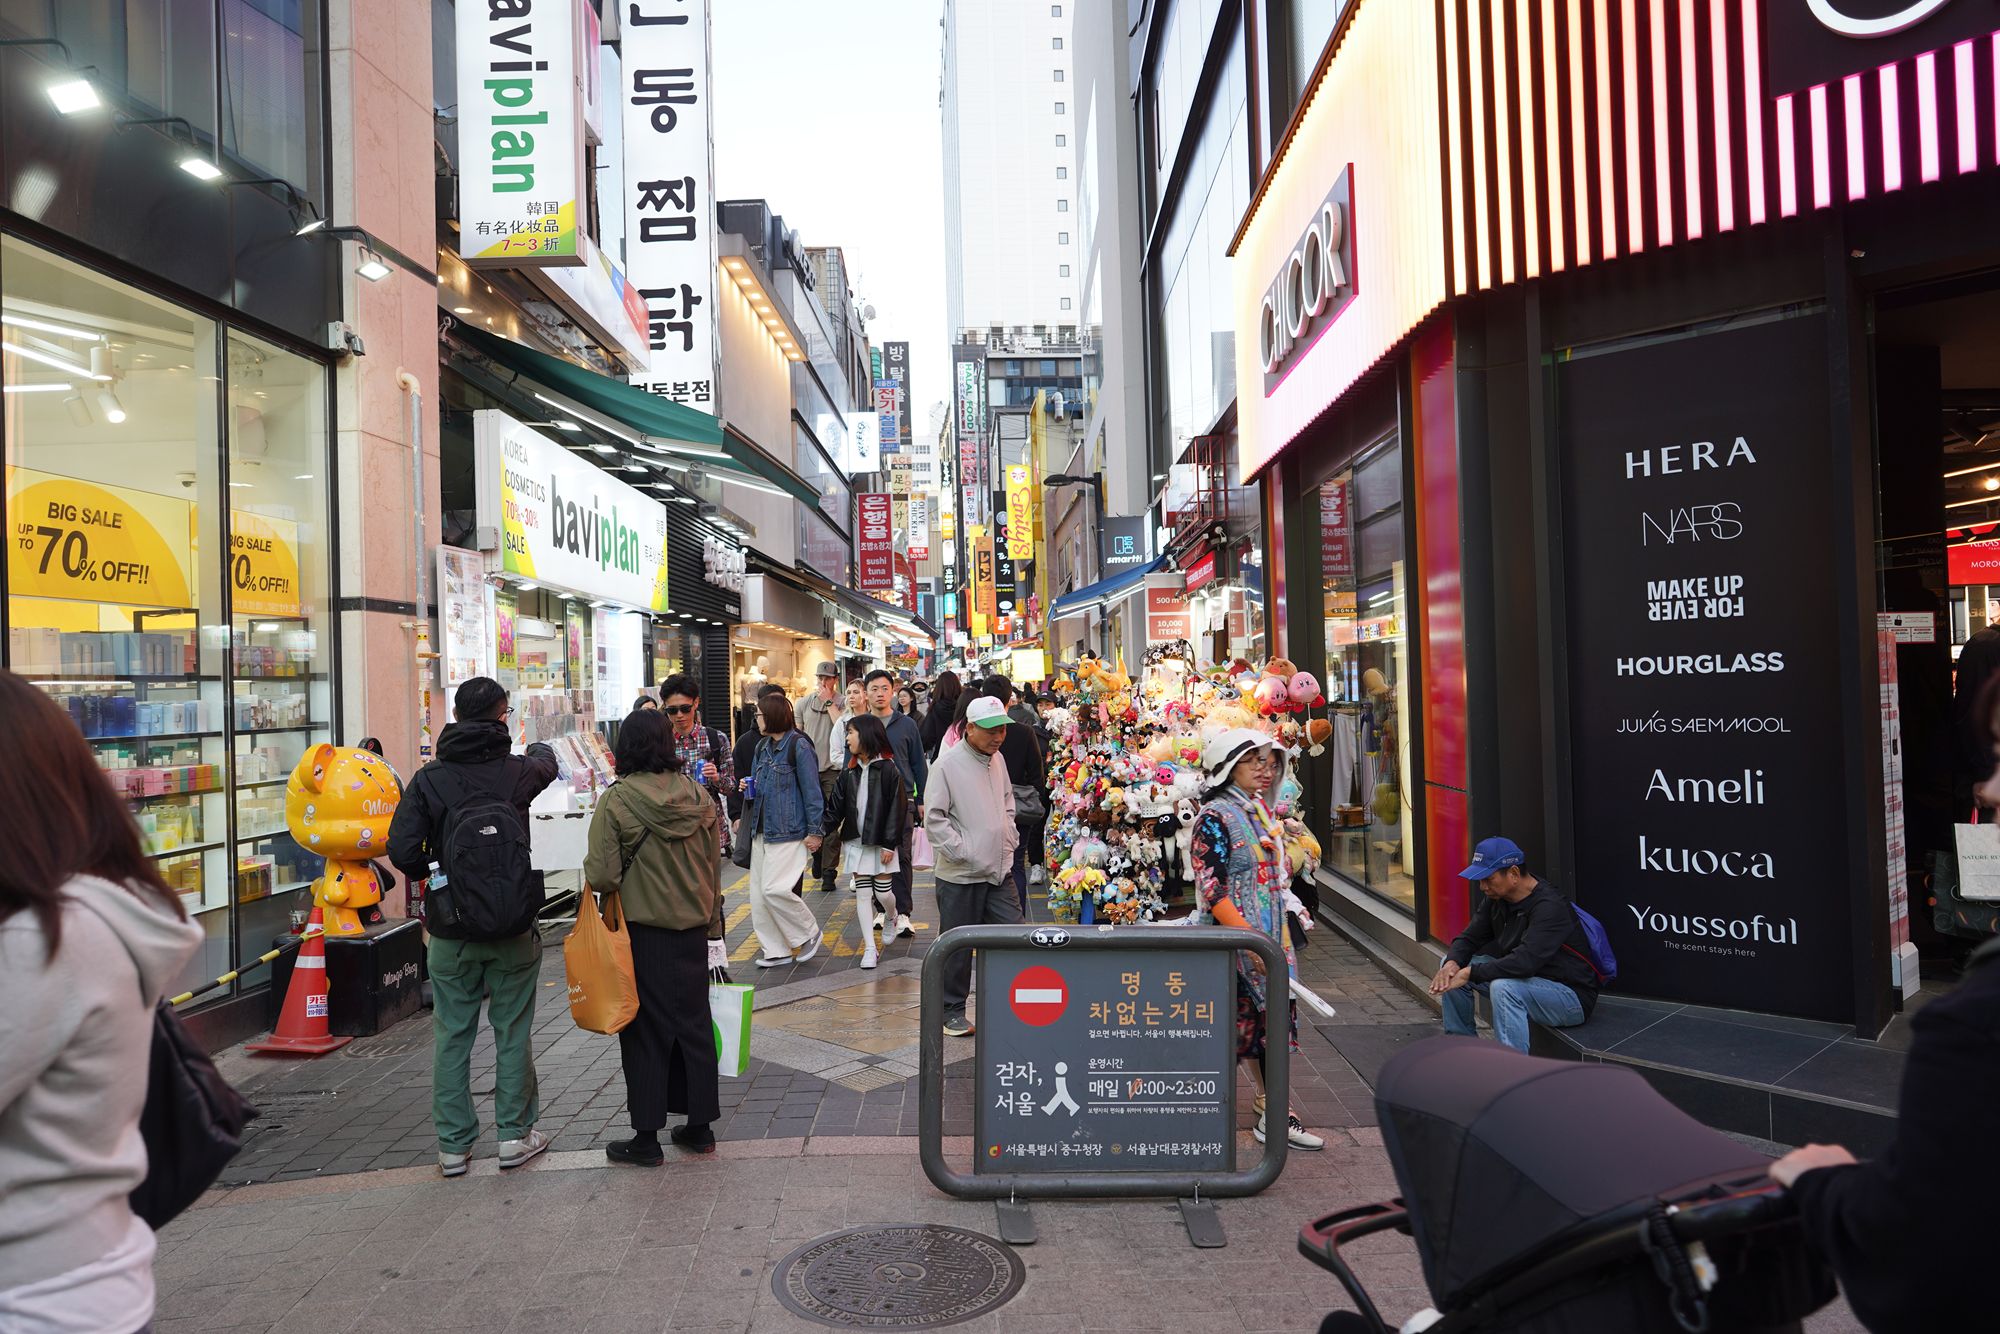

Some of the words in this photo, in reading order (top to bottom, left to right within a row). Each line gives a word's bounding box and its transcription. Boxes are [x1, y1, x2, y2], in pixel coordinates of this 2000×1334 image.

[525, 201, 559, 216] 韓国
[475, 219, 560, 236] 有名化妆品
[1261, 201, 1346, 374] CHICOR
[965, 363, 974, 396] HALAL
[632, 380, 711, 403] 동본점
[503, 438, 529, 466] KOREA
[1625, 436, 1757, 479] HERA
[504, 469, 546, 503] COSMETICS
[47, 501, 76, 520] BIG
[81, 507, 123, 529] SALE
[551, 474, 640, 575] baviplan
[1643, 502, 1743, 546] NARS
[18, 523, 33, 534] UP
[19, 538, 33, 550] TO
[246, 537, 272, 553] SALE
[506, 531, 525, 555] SALE
[36, 526, 97, 582] 70%
[101, 560, 149, 584] OFF!!
[866, 557, 887, 565] sushi
[259, 575, 289, 594] OFF!!
[863, 578, 891, 586] salmon
[1647, 578, 1708, 600] MAKE
[1714, 575, 1744, 596] UP
[1648, 601, 1699, 621] EVER
[1704, 596, 1744, 618] FOR
[1616, 652, 1785, 676] HOURGLASS
[1645, 768, 1764, 805] Ameli
[1639, 835, 1775, 879] kuoca
[1627, 904, 1798, 945] Youssoful
[1664, 941, 1680, 950] The
[1682, 943, 1707, 953] scent
[1709, 946, 1732, 955] stays
[1734, 948, 1756, 957] here
[1089, 1029, 1110, 1038] 걸으면
[1145, 1029, 1166, 1038] 서울이
[995, 1061, 1043, 1086] 걷자,
[1088, 1058, 1124, 1069] 운영시간
[1089, 1079, 1119, 1098] 매일
[994, 1092, 1036, 1116] 서울
[1006, 1143, 1058, 1156] 서울특별시
[1062, 1143, 1103, 1157] 중구청장
[1127, 1142, 1222, 1156] 서울남대문경찰서장
